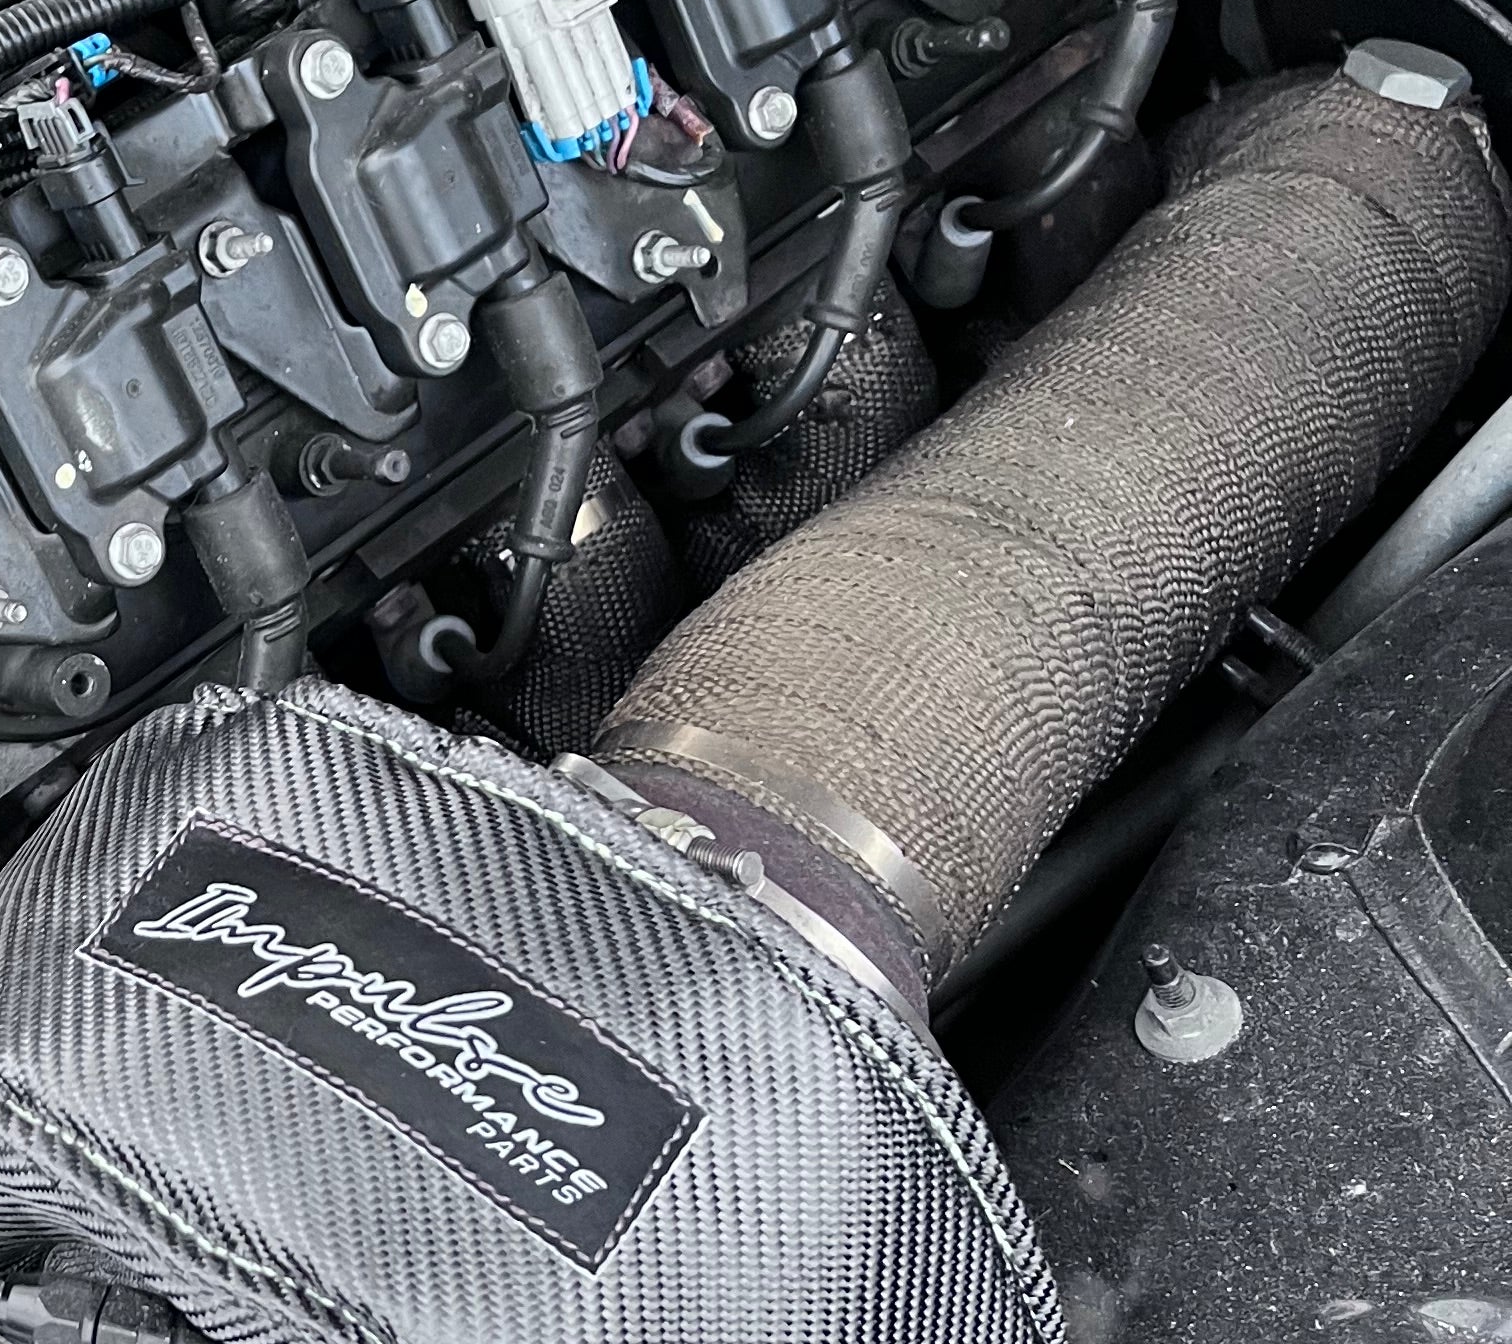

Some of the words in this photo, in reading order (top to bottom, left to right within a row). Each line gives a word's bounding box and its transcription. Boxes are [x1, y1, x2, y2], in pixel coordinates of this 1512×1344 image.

[133, 882, 606, 1128] Impulse
[304, 988, 609, 1196] PERFORMANCE
[465, 1119, 585, 1207] PARTS
